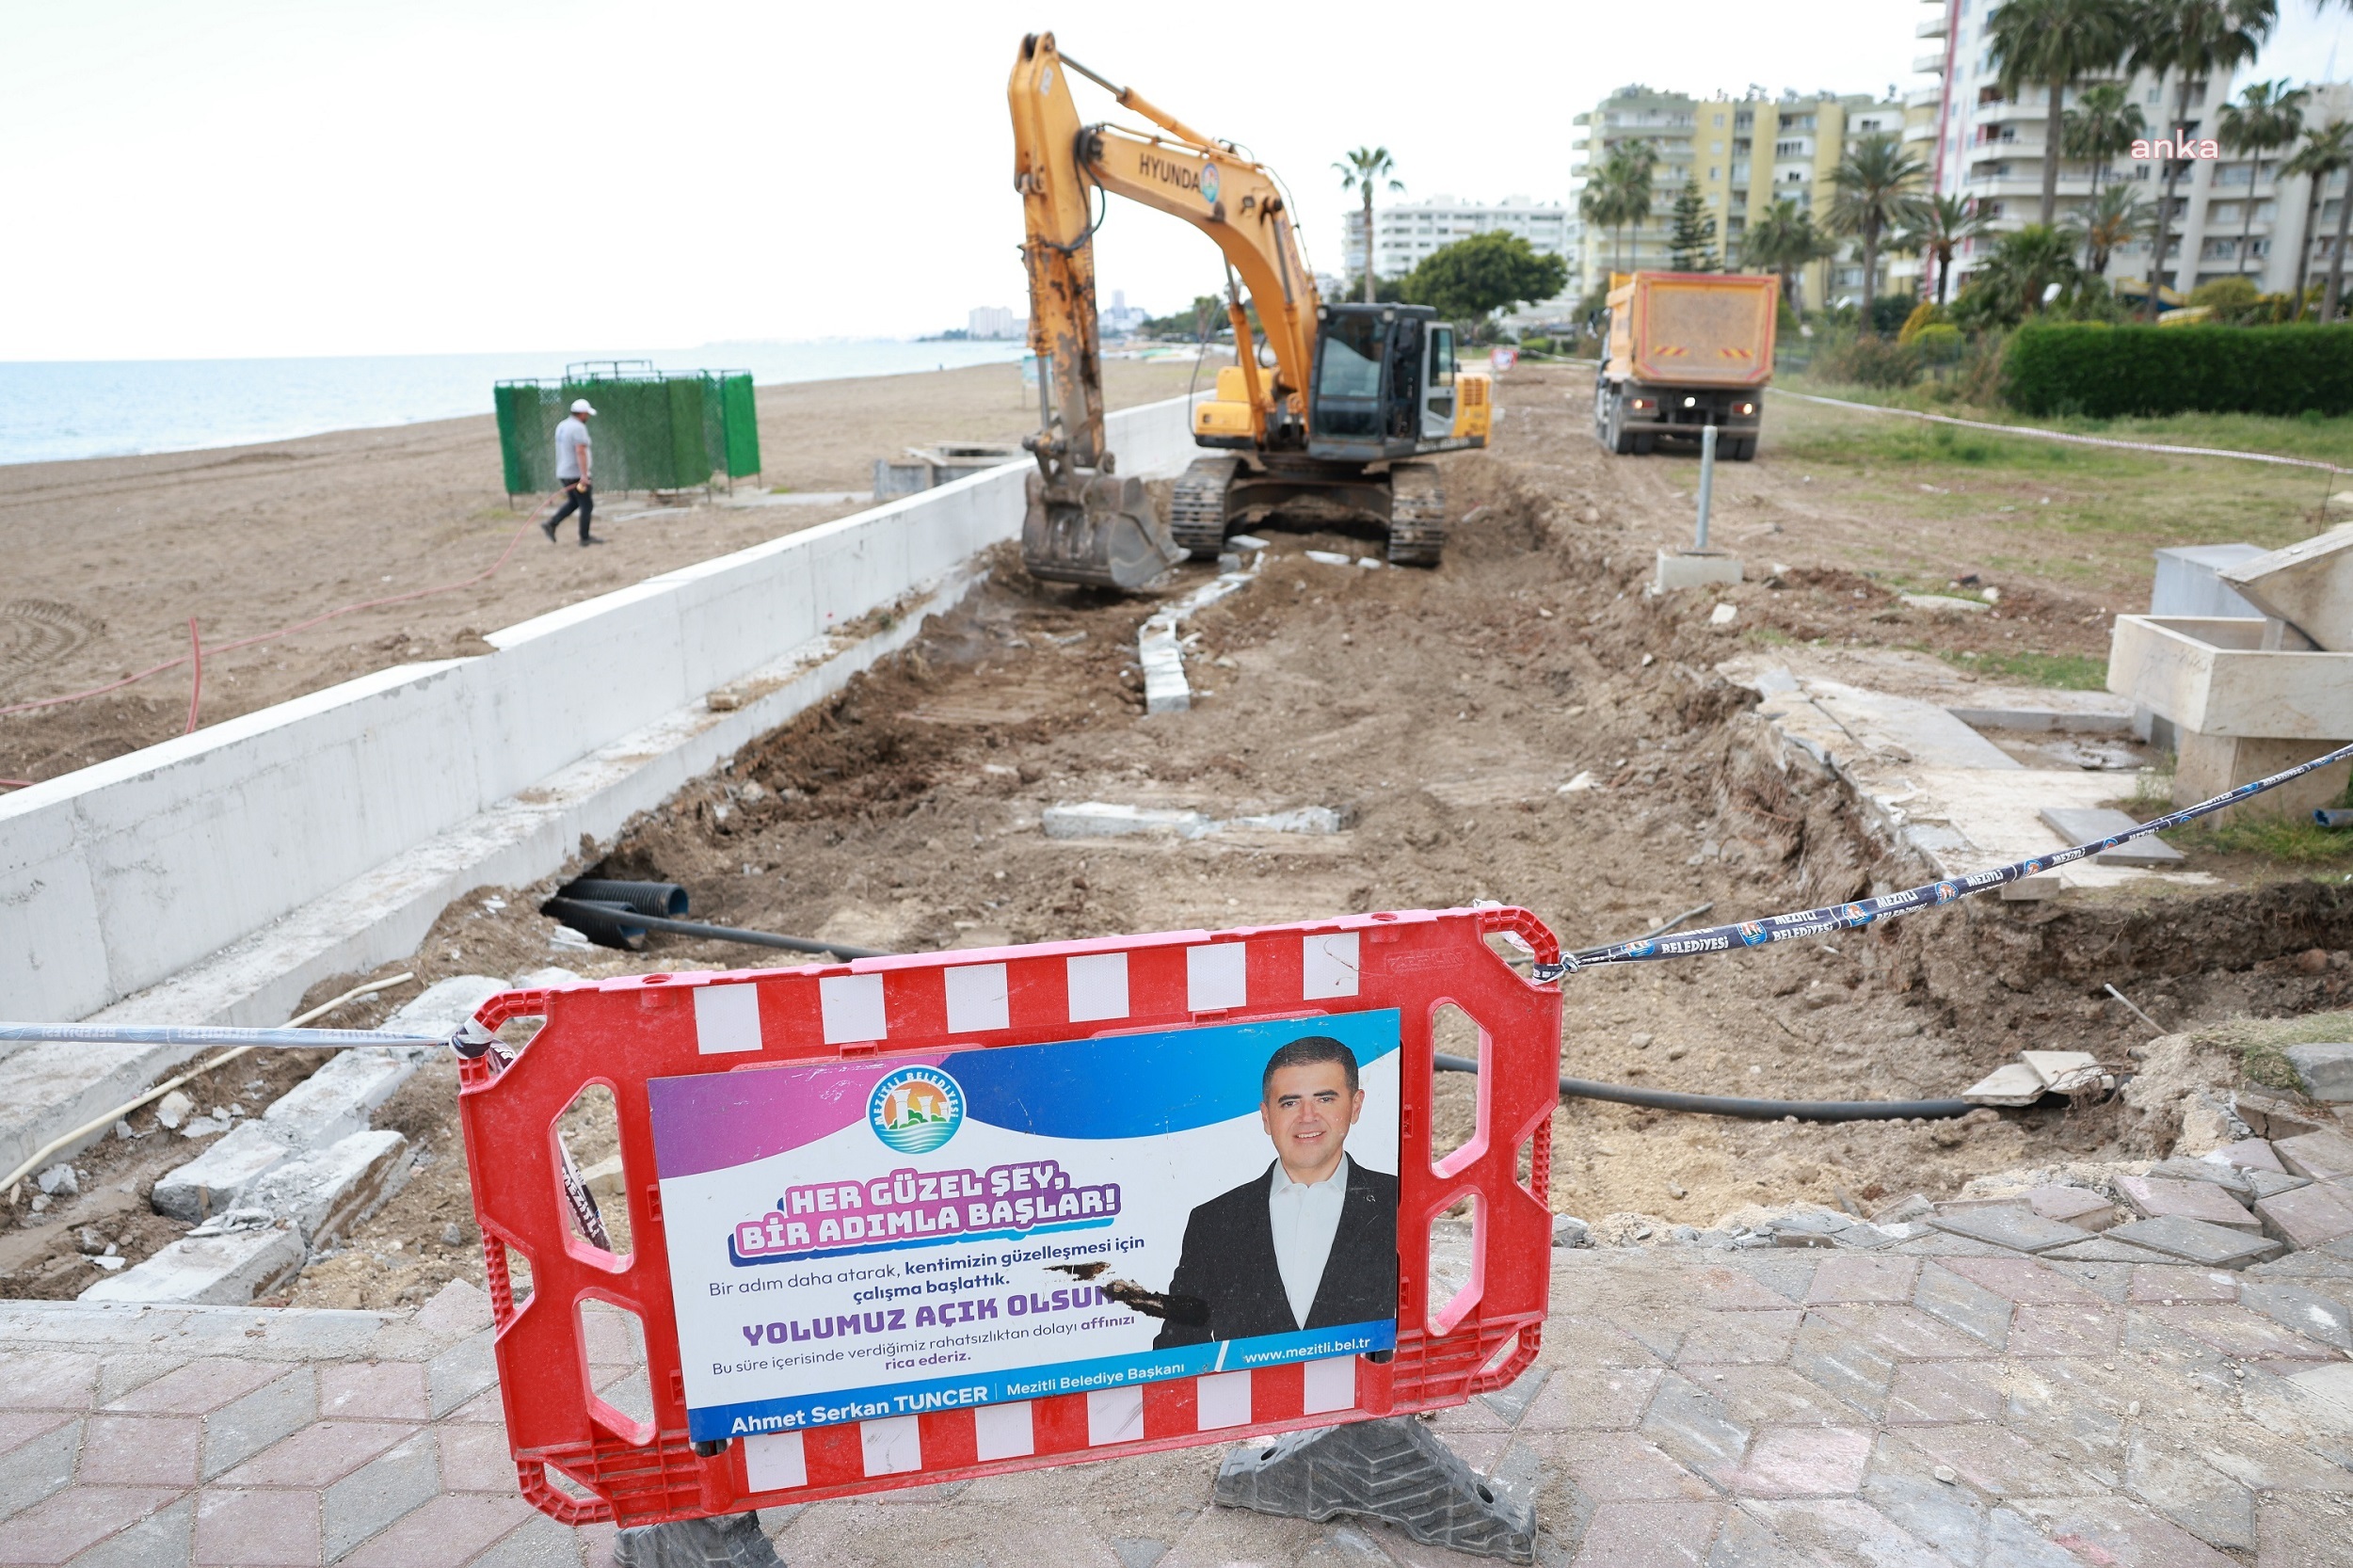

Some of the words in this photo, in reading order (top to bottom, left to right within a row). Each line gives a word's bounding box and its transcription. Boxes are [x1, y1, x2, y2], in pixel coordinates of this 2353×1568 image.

[1139, 152, 1202, 194] HYUNDA
[792, 1186, 863, 1216] HER
[870, 1175, 984, 1207] GÜZEL
[991, 1164, 1065, 1196] ŞEY,
[742, 1212, 811, 1251] BİR
[818, 1206, 960, 1243] ADIMLA
[968, 1187, 1117, 1229] BAŞLAR!
[709, 1281, 734, 1297] Bir
[739, 1274, 784, 1294] adım
[787, 1270, 834, 1288] daha
[837, 1262, 902, 1285] atarak,
[904, 1251, 998, 1275] kentimizin
[1000, 1239, 1112, 1268] güzelleşmesi
[1115, 1236, 1145, 1255] için
[853, 1280, 922, 1304] çalışma
[925, 1271, 1011, 1296] başlattık.
[712, 1362, 732, 1375] Bu
[735, 1356, 769, 1372] süre
[772, 1348, 845, 1369] içerisinde
[847, 1338, 926, 1361] verdiğimiz
[929, 1326, 1030, 1349] rahatsızlıktan
[1032, 1320, 1078, 1339] dolayı
[1080, 1315, 1136, 1331] affınızı
[743, 1308, 907, 1347] YOLUMUZ
[915, 1299, 999, 1328] AÇIK
[731, 1409, 806, 1434] Ahmet
[811, 1400, 890, 1422] Serkan
[894, 1385, 988, 1411] TUNCER
[1006, 1377, 1057, 1396] Mezitli
[1060, 1369, 1124, 1390] Belediye
[1128, 1362, 1185, 1382] Başkanı
[1245, 1337, 1371, 1363] www.mezitli.bel.tr
[885, 1356, 916, 1370] rica
[918, 1351, 972, 1367] ederiz.
